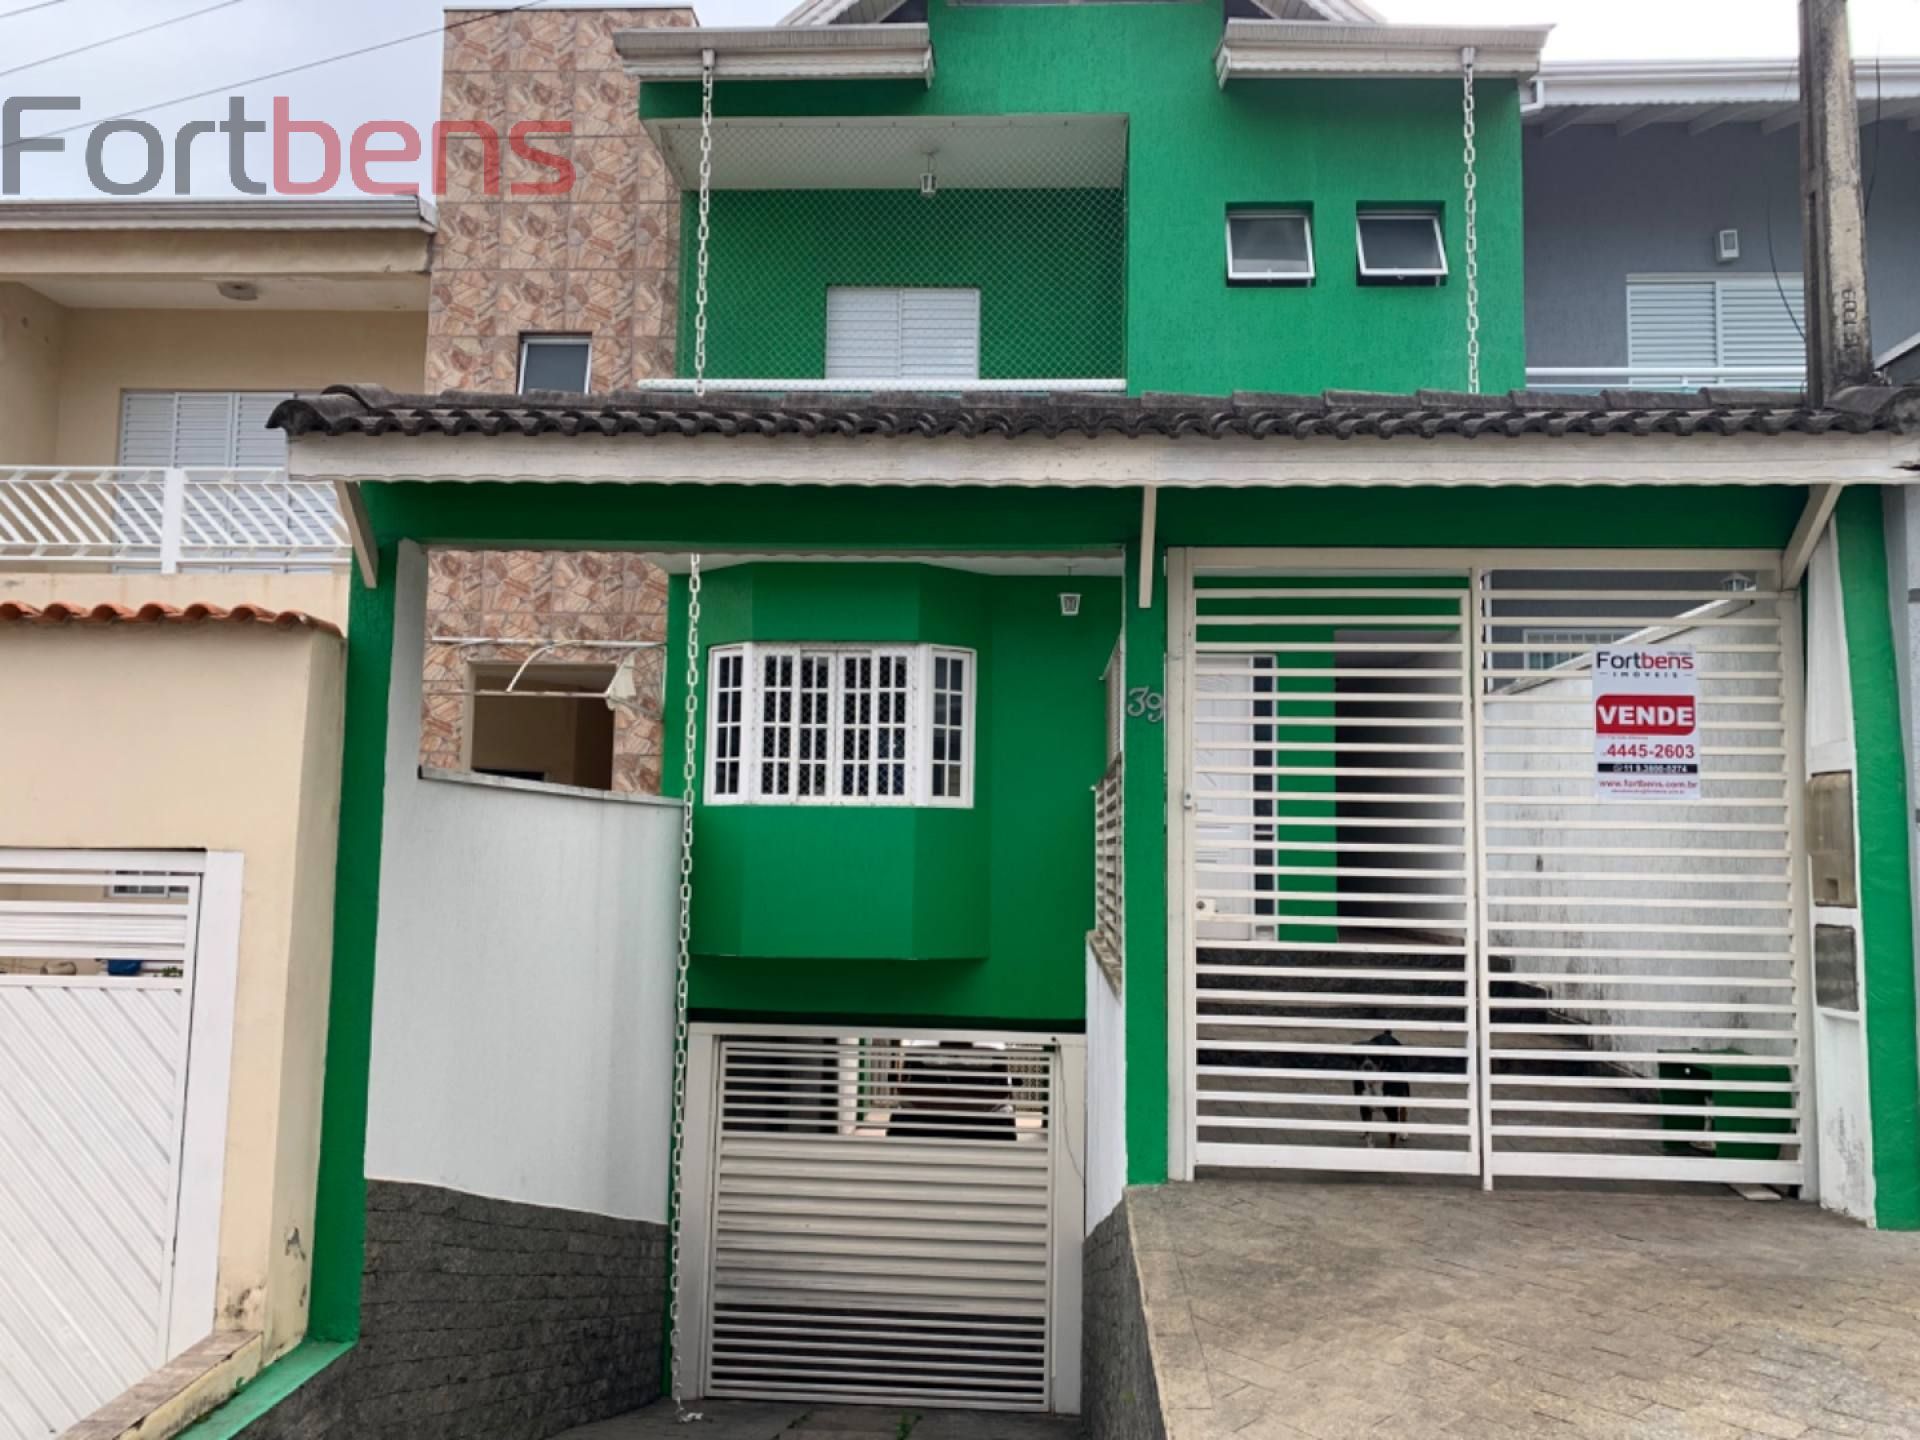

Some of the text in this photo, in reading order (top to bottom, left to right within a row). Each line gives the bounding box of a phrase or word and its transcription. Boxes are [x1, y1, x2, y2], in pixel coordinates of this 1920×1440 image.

[1596, 651, 1694, 669] Fortbens
[1127, 685, 1165, 723] 39
[1597, 705, 1694, 726] VENDE
[1607, 743, 1695, 759] 4445-2603
